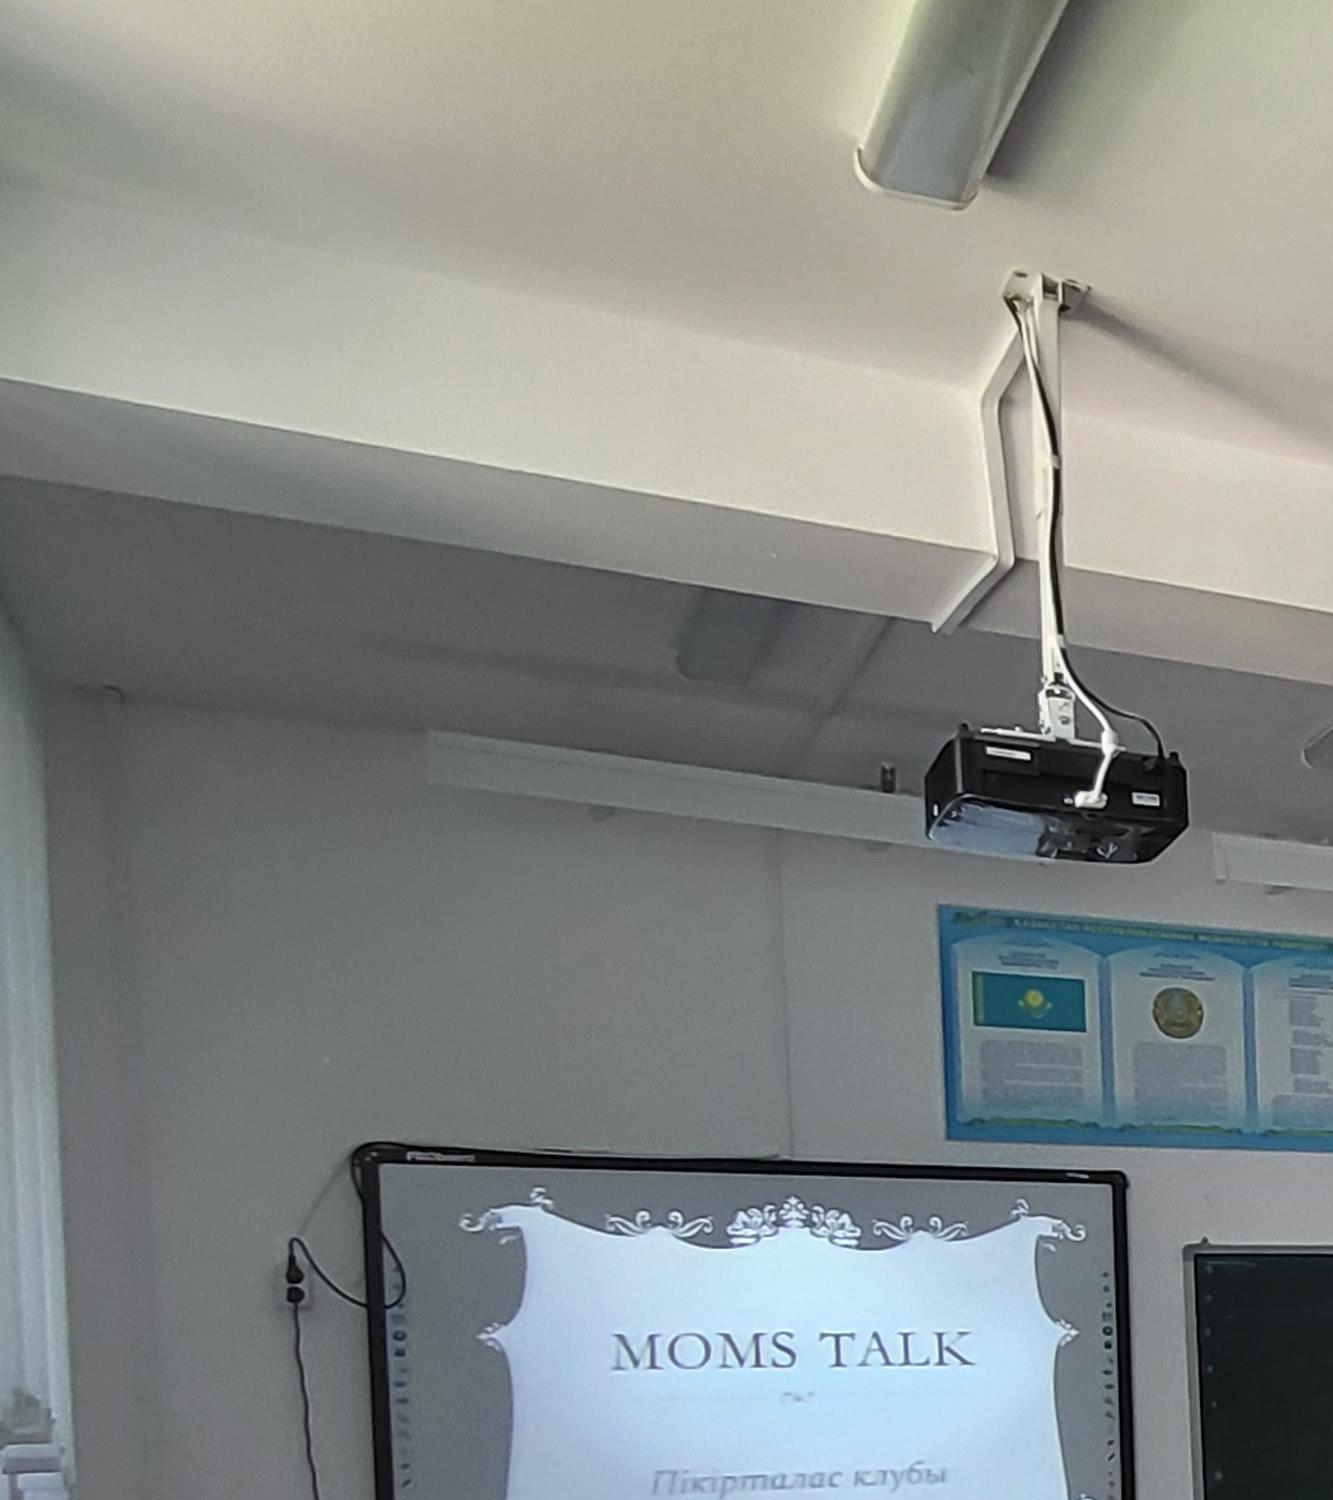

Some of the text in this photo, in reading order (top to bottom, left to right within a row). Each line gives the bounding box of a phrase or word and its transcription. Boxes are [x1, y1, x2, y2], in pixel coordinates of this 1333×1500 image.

[611, 1330, 975, 1371] MOMS TALK
[650, 1459, 947, 1500] Пікірталас клубы
